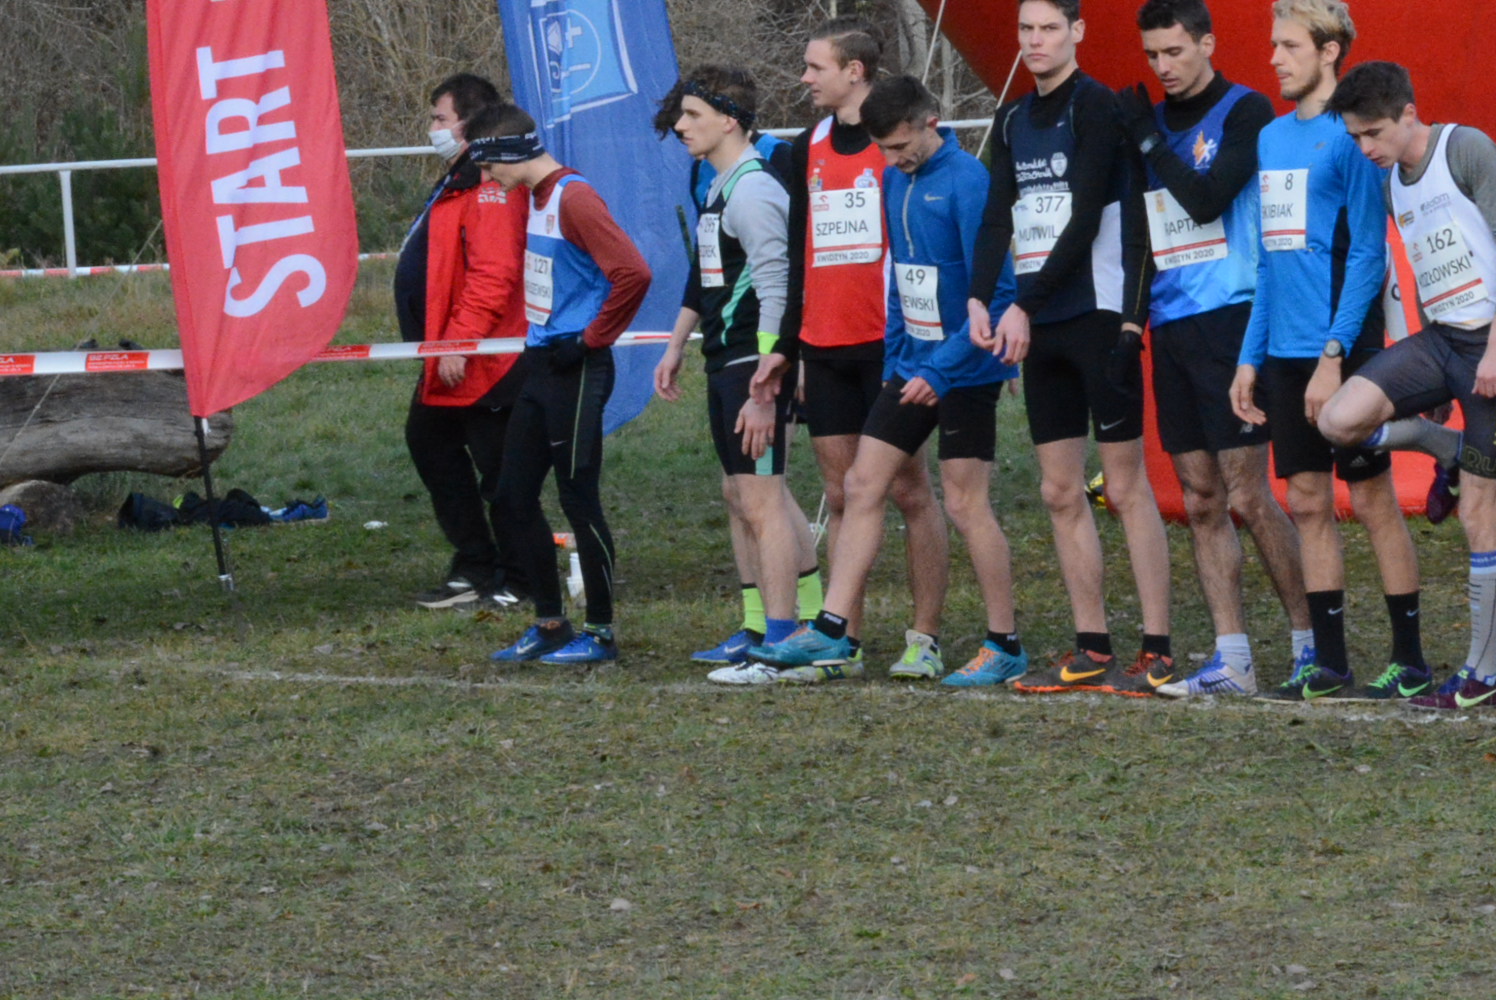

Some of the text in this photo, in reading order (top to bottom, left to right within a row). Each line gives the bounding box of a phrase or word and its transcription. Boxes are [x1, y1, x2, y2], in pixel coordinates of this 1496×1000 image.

[195, 46, 327, 319] START
[1284, 172, 1294, 191] 8
[844, 191, 866, 209] 35
[1035, 195, 1065, 214] 377
[815, 219, 869, 237] SZPEJNA
[1426, 228, 1457, 255] 162
[816, 250, 870, 264] KWIDZYN 2020
[1193, 248, 1215, 260] 2020
[533, 259, 548, 275] 127
[904, 268, 926, 286] 49
[902, 295, 935, 312] EWSKI
[1456, 291, 1475, 305] 2020
